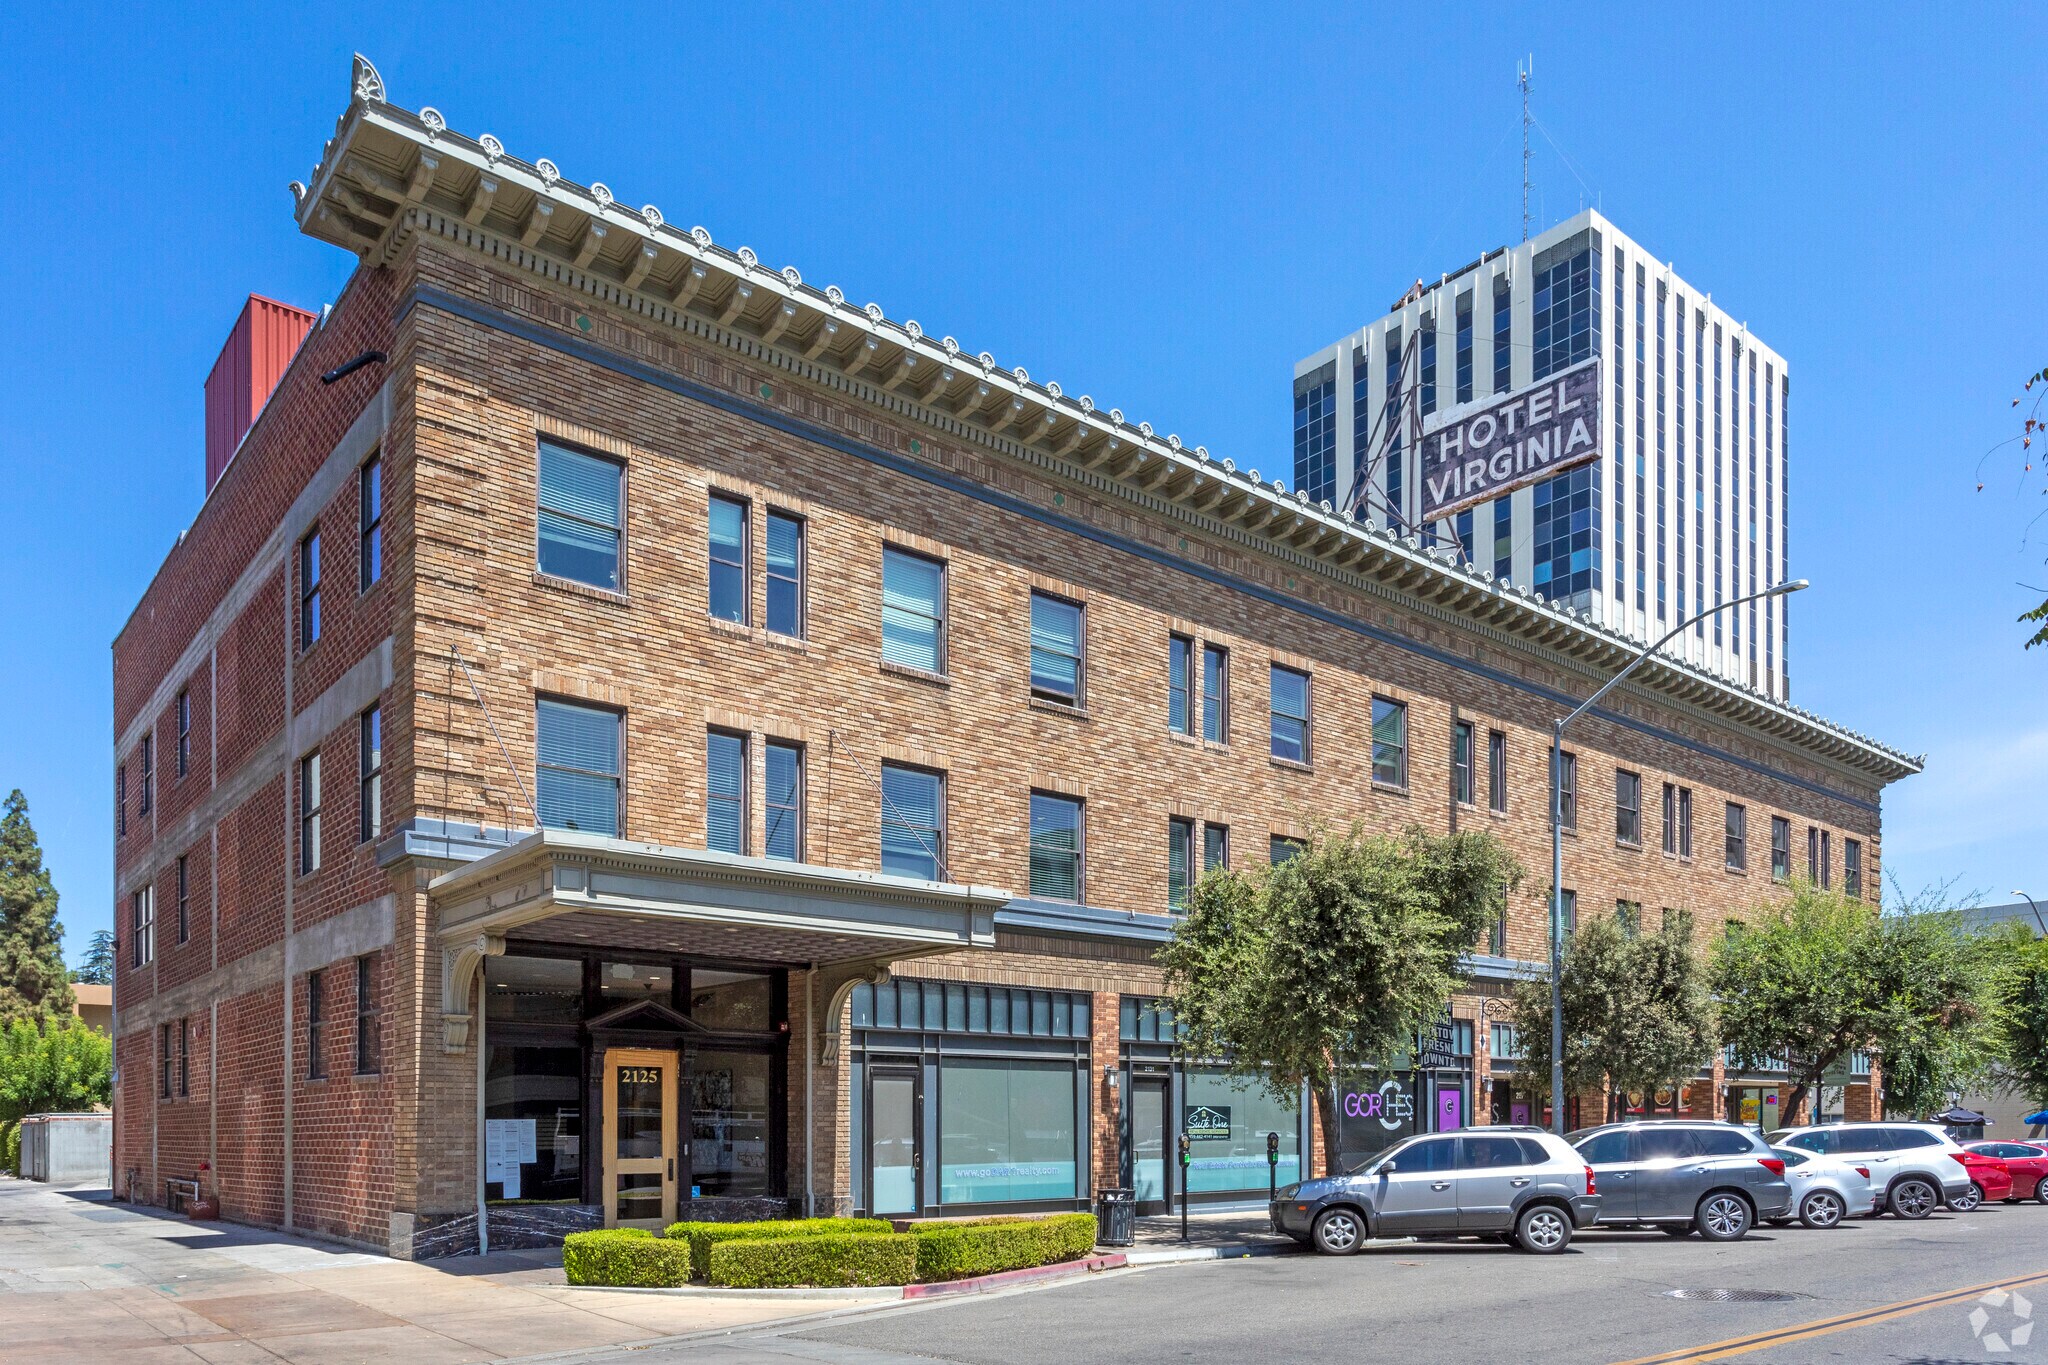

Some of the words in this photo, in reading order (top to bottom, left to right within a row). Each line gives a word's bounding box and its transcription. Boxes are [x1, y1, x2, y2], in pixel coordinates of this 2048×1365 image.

[1440, 381, 1582, 463] HOTEL
[1426, 416, 1593, 506] VIRGINIA
[622, 1070, 658, 1084] 2125
[1187, 1114, 1210, 1129] Suite
[1212, 1114, 1228, 1129] One
